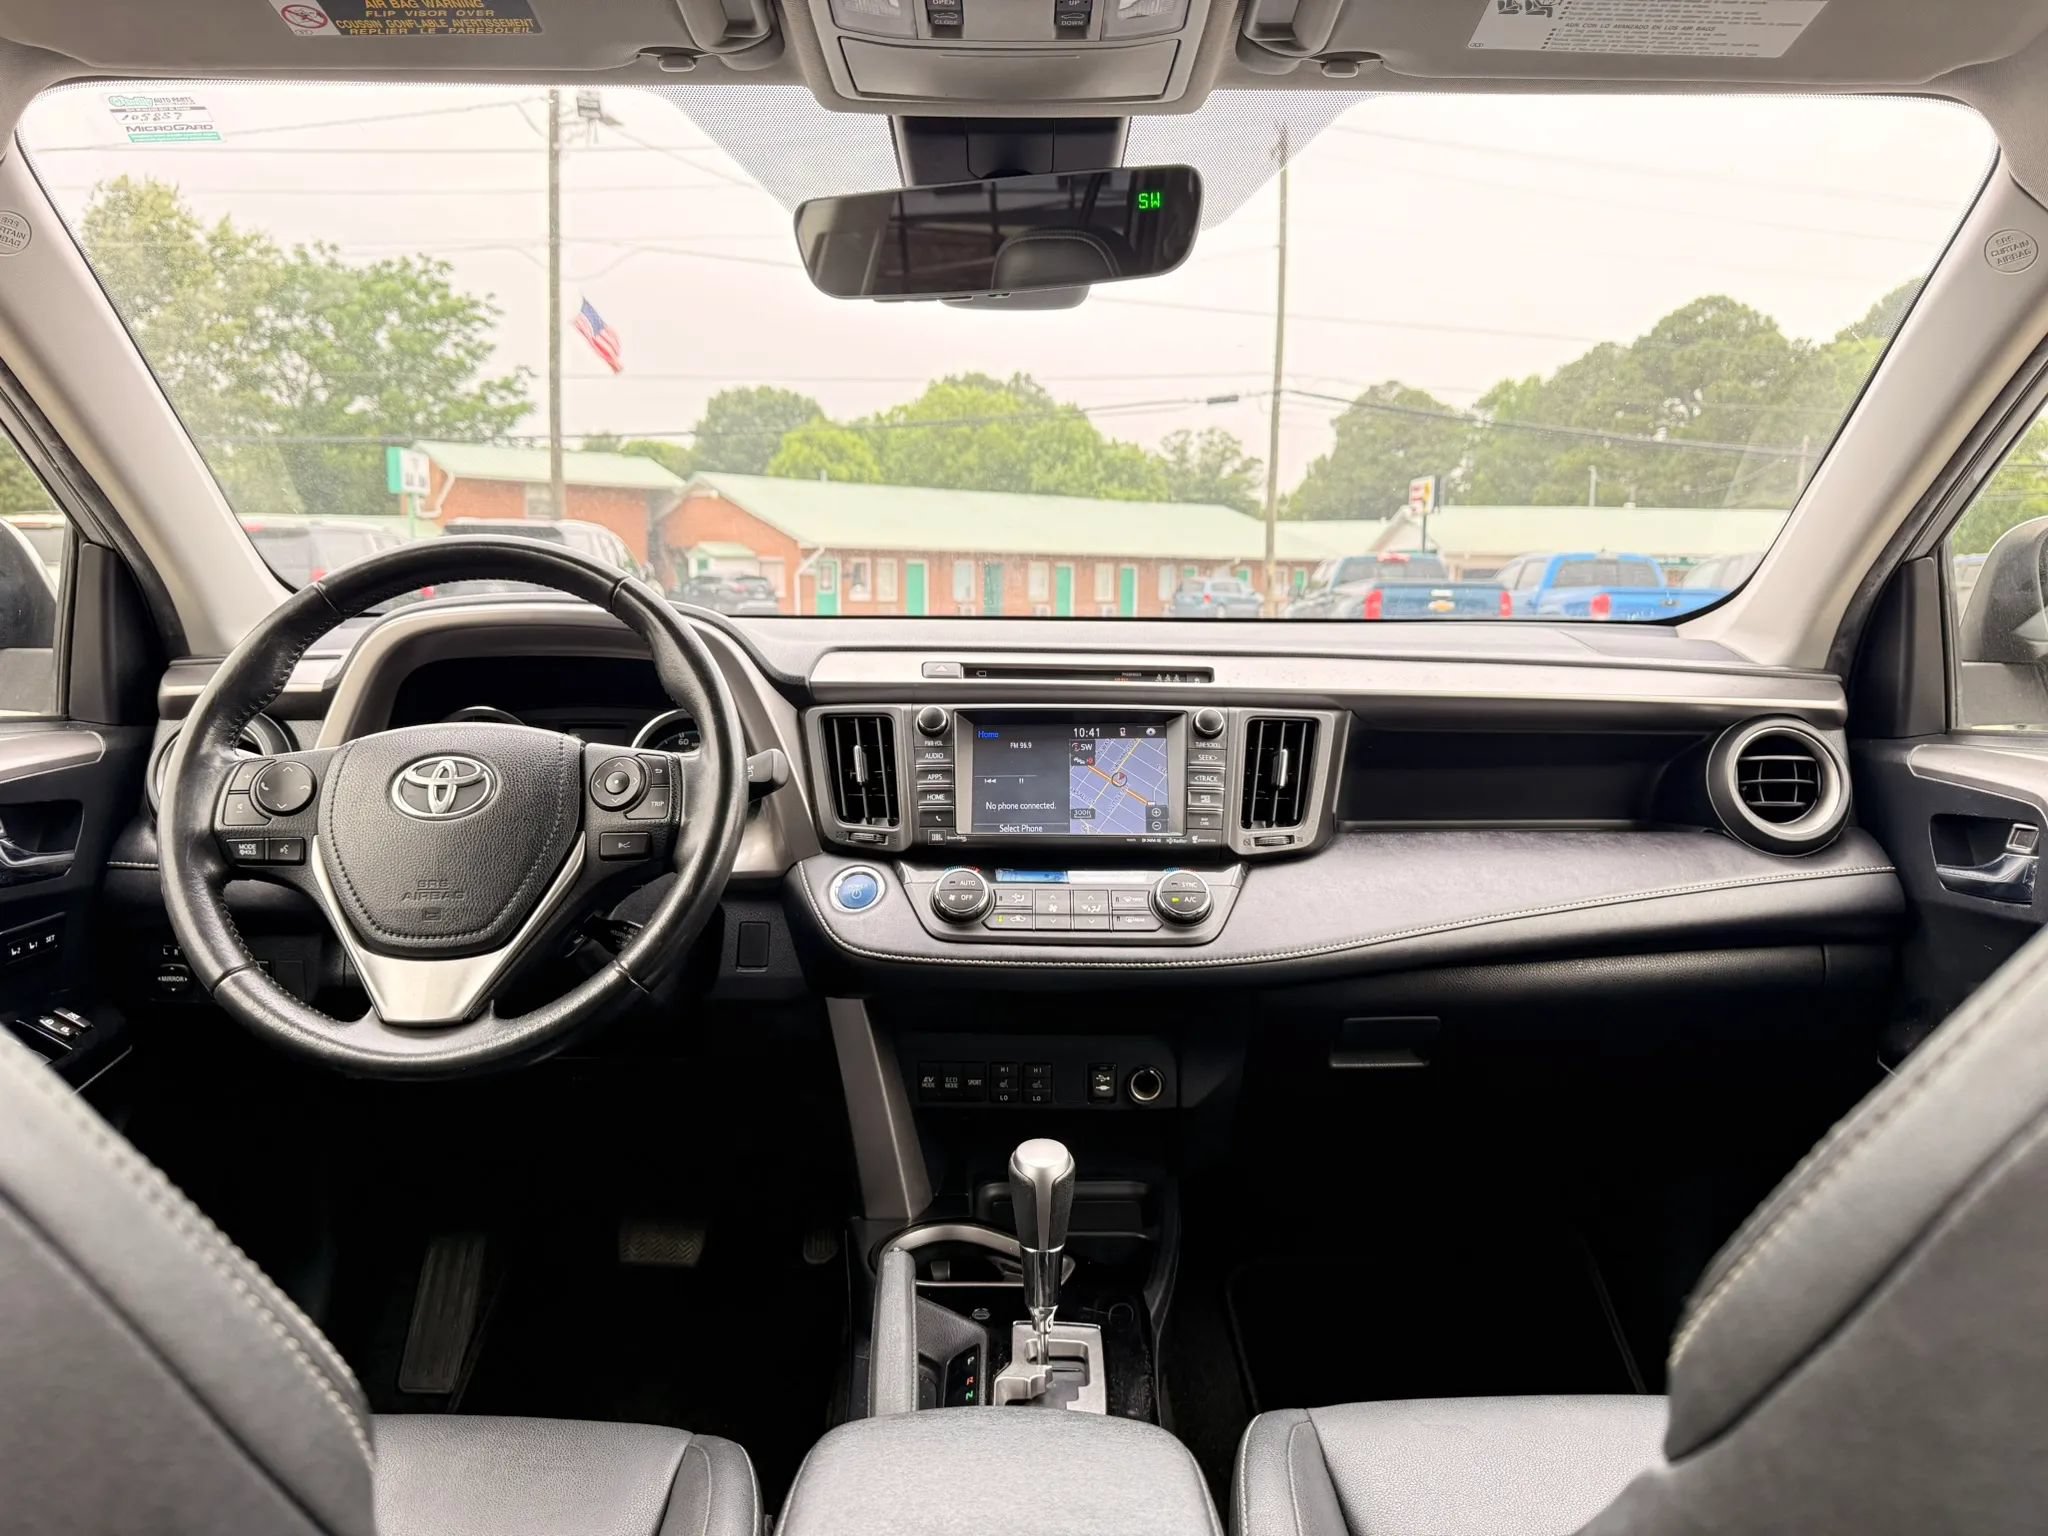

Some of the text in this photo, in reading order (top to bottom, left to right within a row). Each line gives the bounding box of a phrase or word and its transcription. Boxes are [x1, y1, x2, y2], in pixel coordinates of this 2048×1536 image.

[364, 0, 485, 8] AIR BAG WARNING
[335, 18, 534, 29] COUSSIN GONFLABLE AVERTISSEMENT
[1138, 191, 1160, 209] SW
[1990, 239, 2030, 257] CURTAIN
[1997, 249, 2032, 265] AIRBAG
[977, 730, 999, 739] Home
[1073, 727, 1101, 738] 10:41
[678, 738, 690, 746] 60
[1080, 743, 1093, 751] SW
[926, 793, 945, 801] HOME
[985, 801, 1057, 812] No phone connected.
[999, 823, 1043, 833] Select Phone
[417, 879, 450, 890] SRS
[402, 890, 465, 901] AIRBAG
[967, 1355, 975, 1365] P
[966, 1376, 974, 1386] R
[965, 1390, 974, 1401] N
